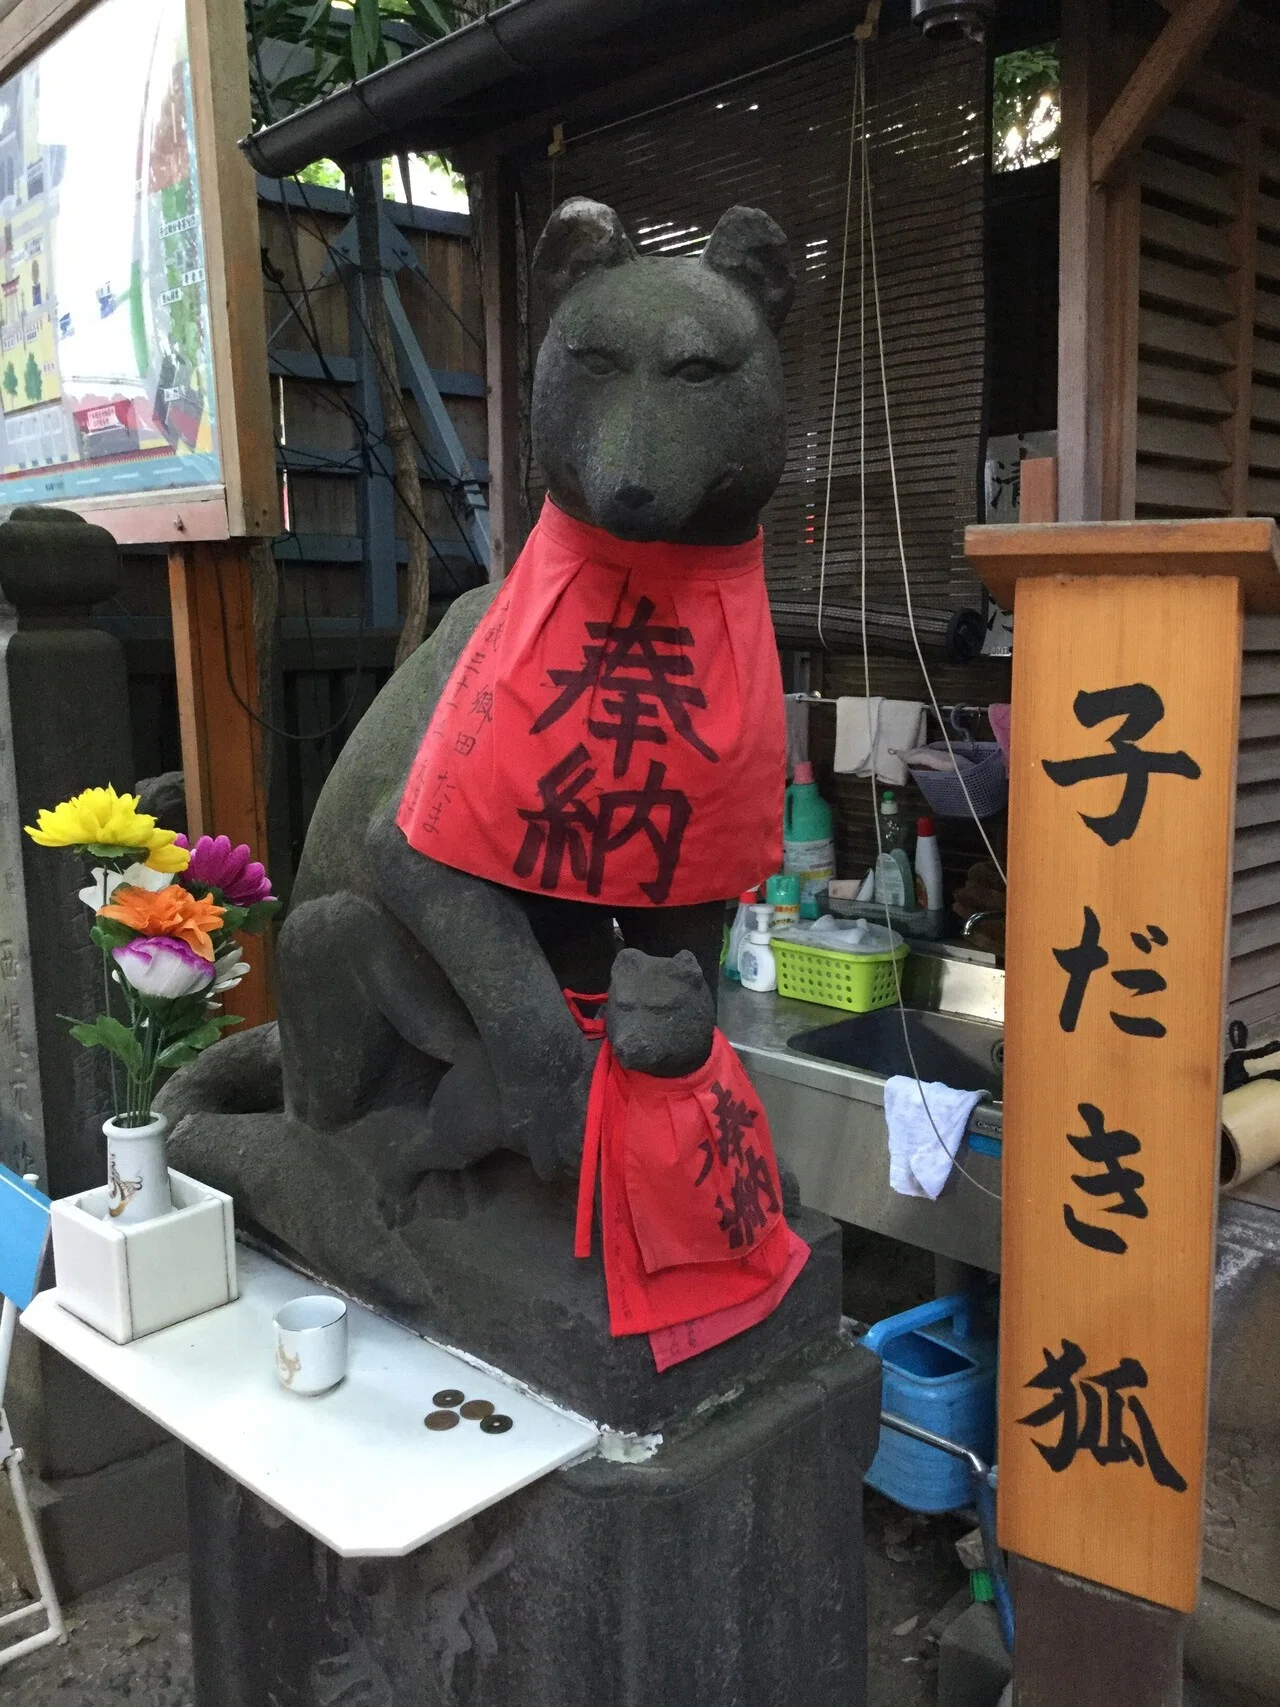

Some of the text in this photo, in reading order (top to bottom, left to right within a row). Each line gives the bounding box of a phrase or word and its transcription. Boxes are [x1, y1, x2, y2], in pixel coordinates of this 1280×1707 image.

[513, 596, 720, 905] 奉納
[695, 1080, 780, 1249] 奉納
[1017, 683, 1201, 1492] 子だき狐
